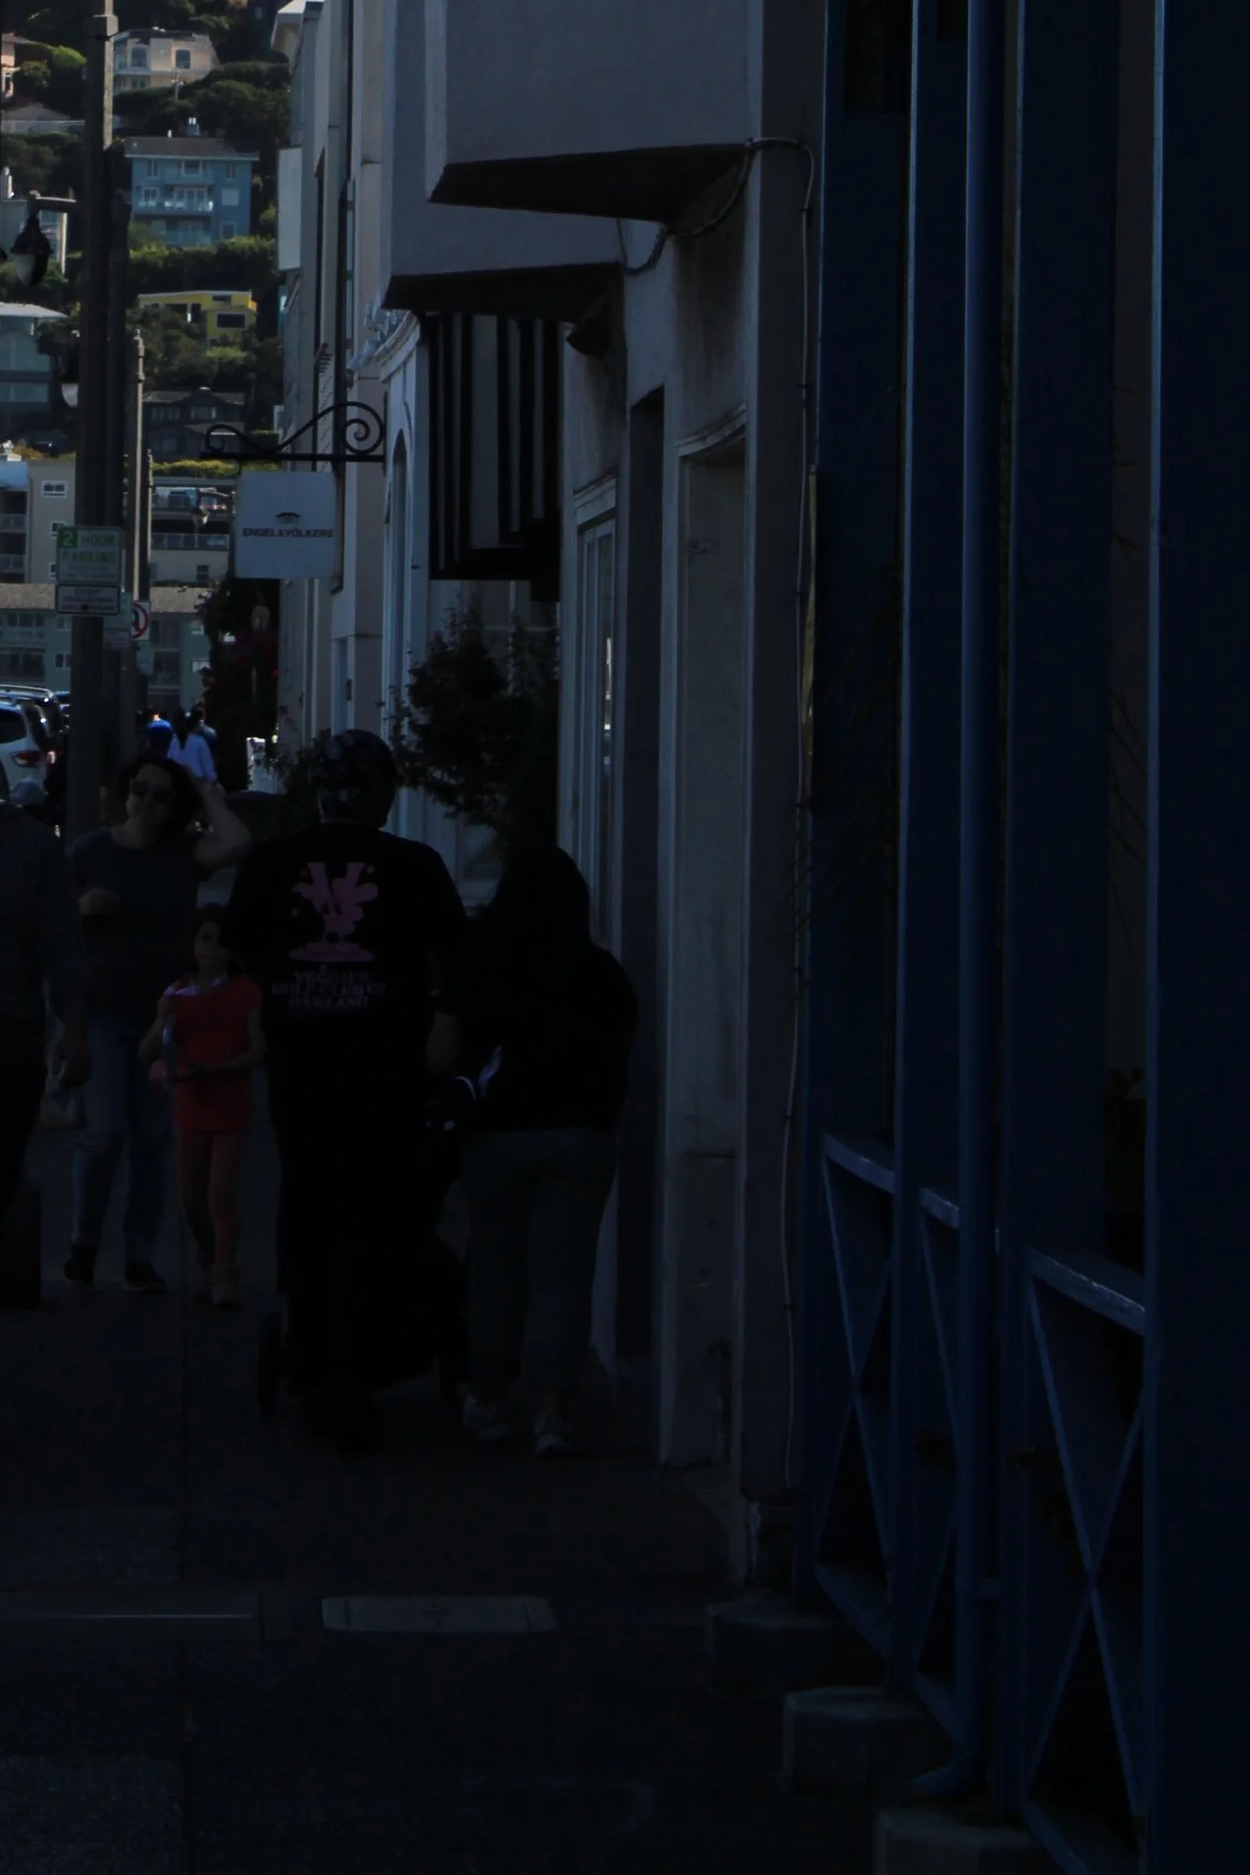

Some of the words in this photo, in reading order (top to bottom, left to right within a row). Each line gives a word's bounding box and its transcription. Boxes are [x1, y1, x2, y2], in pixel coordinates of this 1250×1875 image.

[63, 530, 74, 547] 2
[81, 534, 115, 547] HOUR
[61, 550, 116, 563] PARKING
